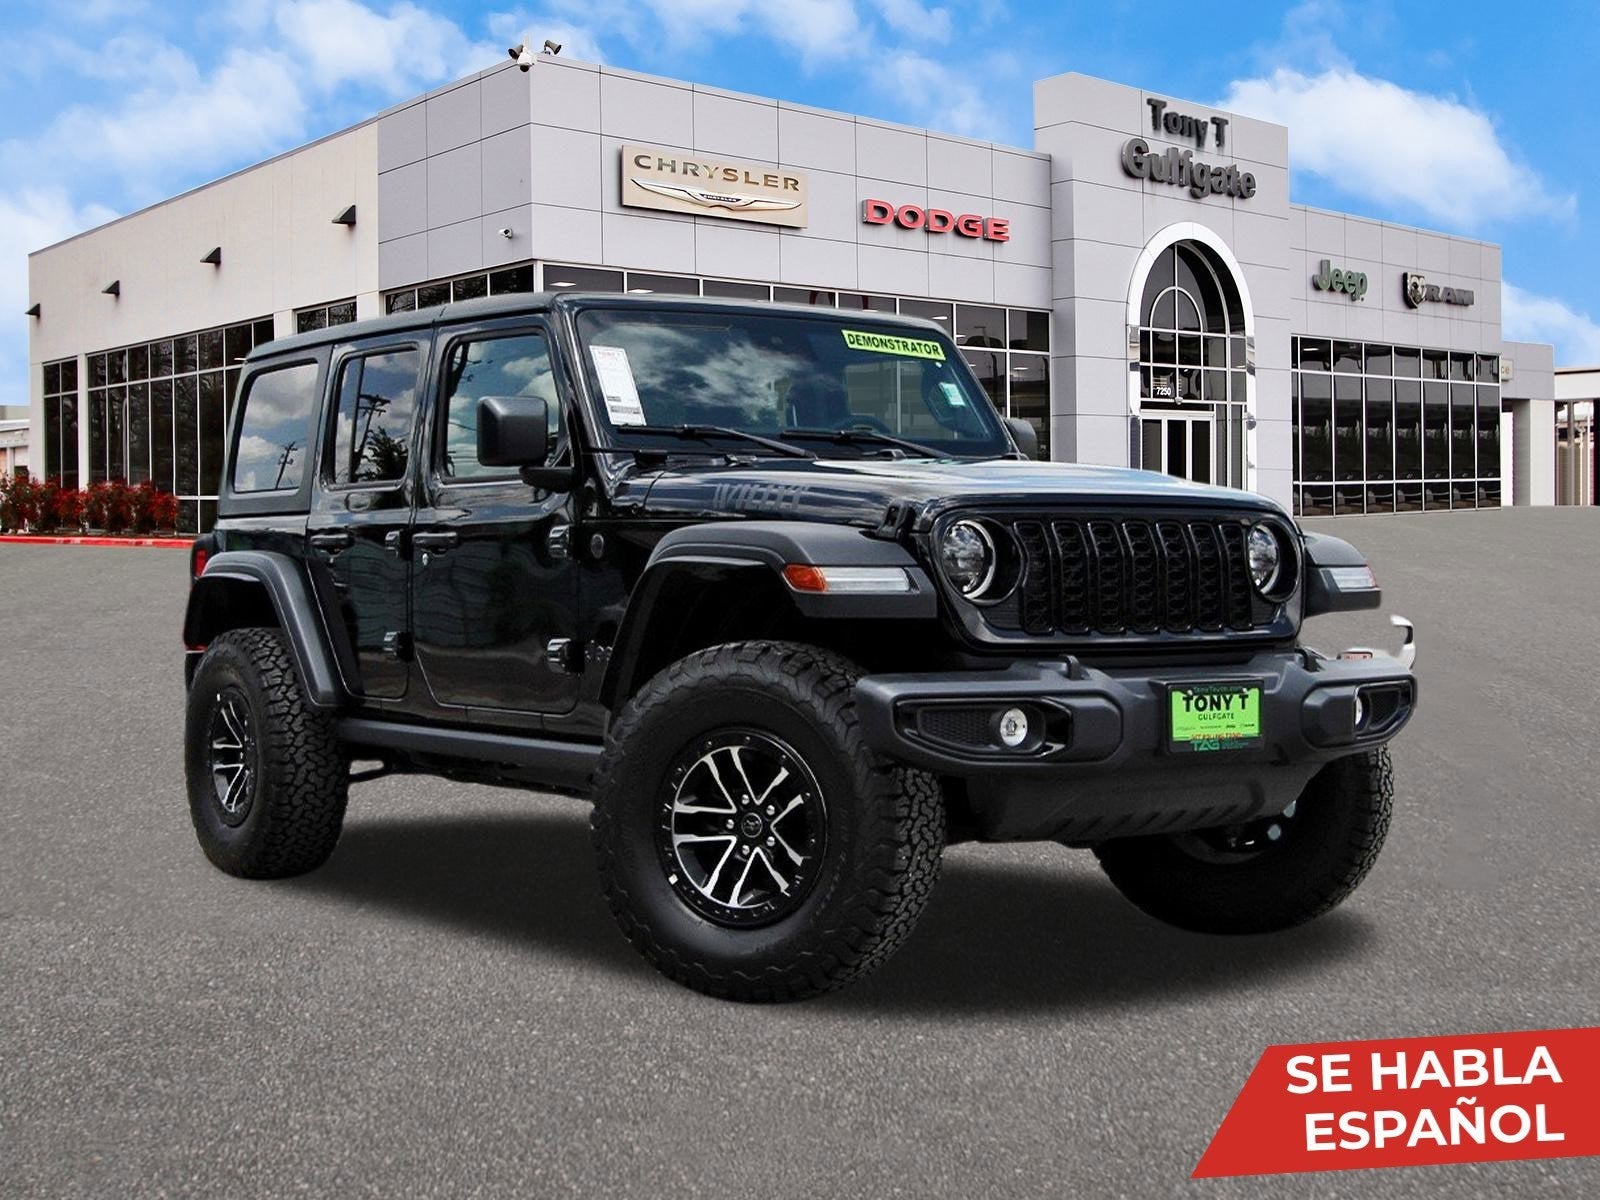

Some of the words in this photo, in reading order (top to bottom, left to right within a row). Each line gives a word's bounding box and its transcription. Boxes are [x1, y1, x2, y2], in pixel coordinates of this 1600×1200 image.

[1146, 98, 1208, 148] Tony
[1210, 116, 1229, 148] T
[633, 154, 800, 192] CHRYSLER
[1121, 138, 1256, 199] Gulfgate
[862, 199, 1010, 242] DODGE
[1312, 259, 1368, 302] Jeep
[1424, 284, 1475, 306] RAM
[847, 333, 941, 355] DEMONSTRATOR
[1182, 694, 1234, 712] TONY
[1239, 694, 1249, 710] T
